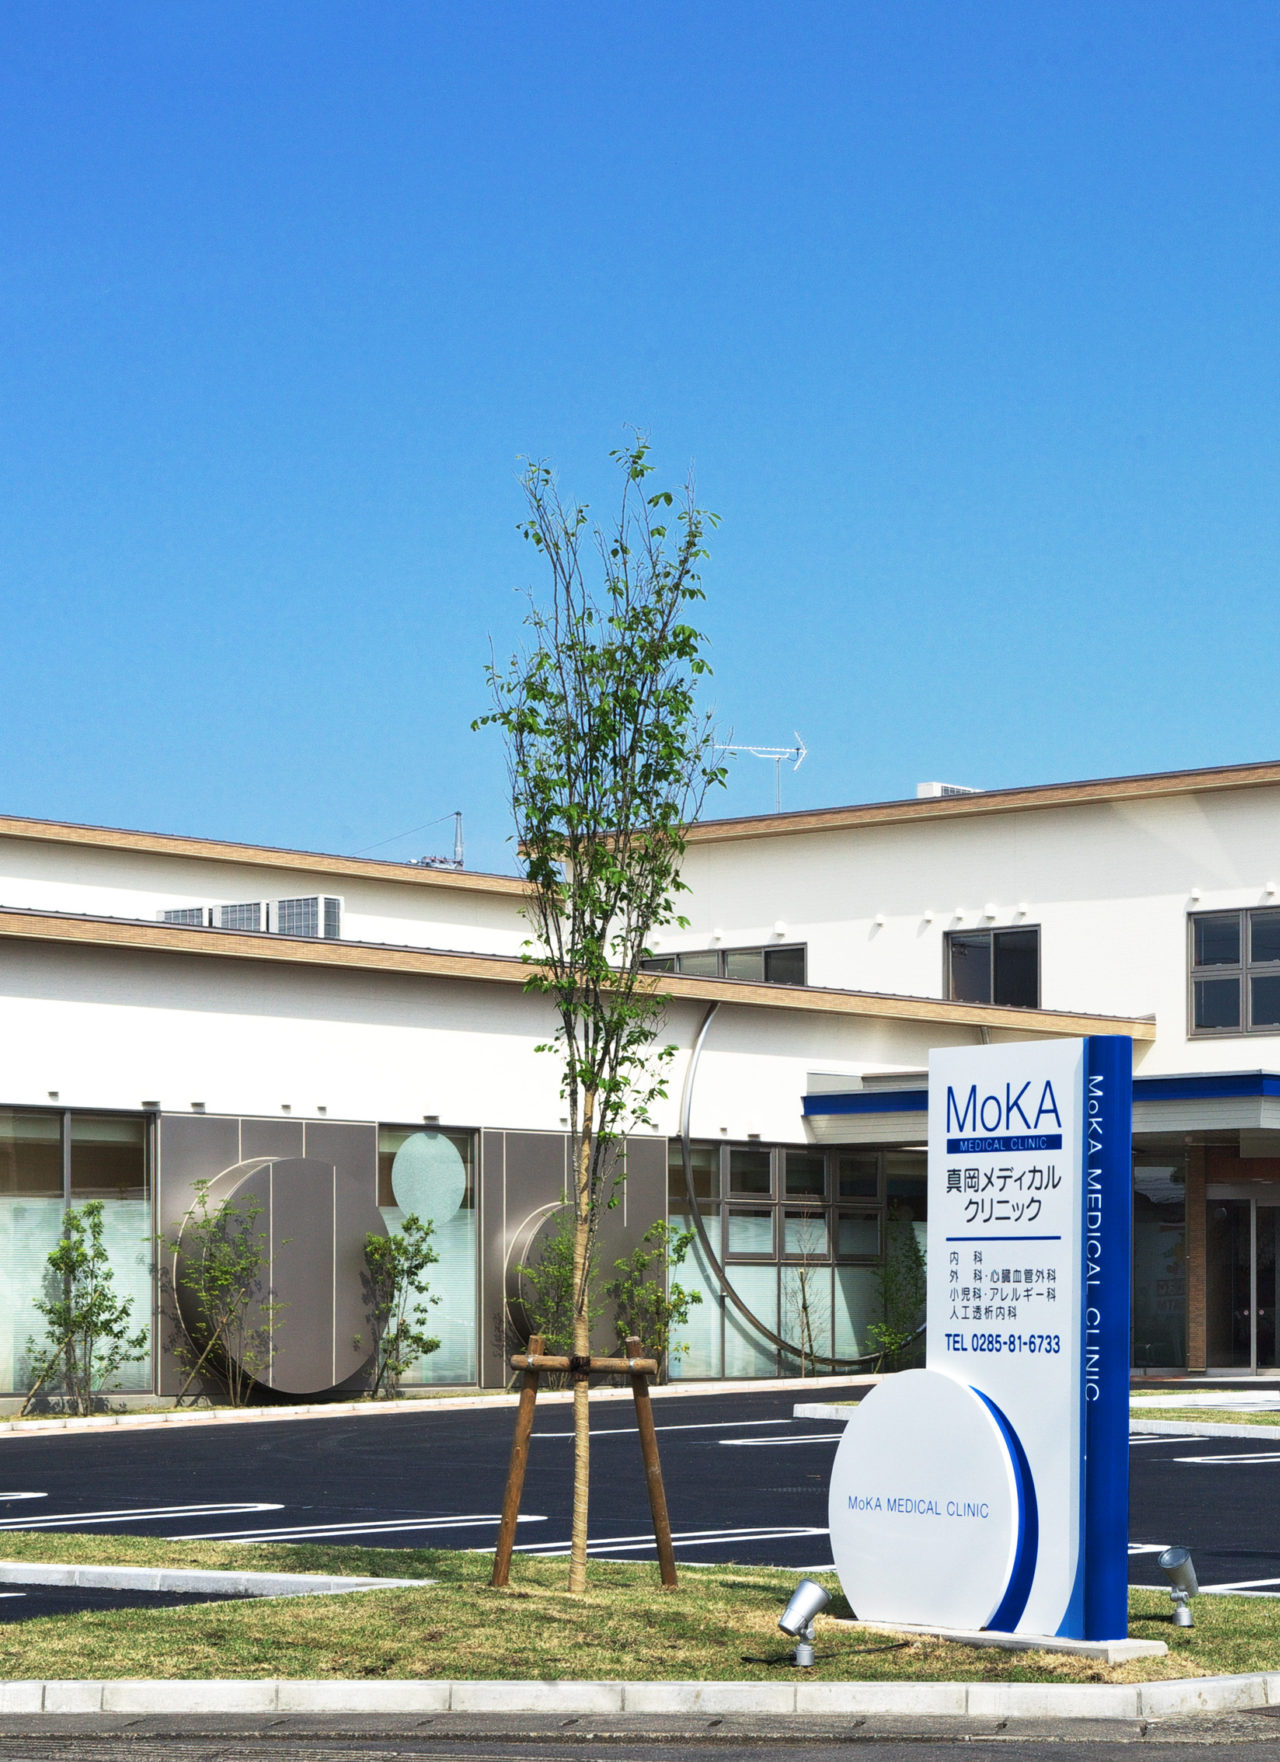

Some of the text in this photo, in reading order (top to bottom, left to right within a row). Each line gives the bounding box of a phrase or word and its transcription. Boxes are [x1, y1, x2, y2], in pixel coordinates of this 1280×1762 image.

[946, 1080, 1062, 1133] MoKA
[960, 1136, 1048, 1152] MEDICAL CLINIC
[946, 1165, 1062, 1193] 真岡メディカル
[964, 1196, 1042, 1223] クリニック
[1085, 1075, 1104, 1402] MoKA MEDICAL CLINIC
[949, 1305, 1017, 1320] 人工透析内科
[944, 1333, 1061, 1354] TEL 0285-81-6733
[848, 1495, 989, 1519] MoKA MEDICAL CLINIC
